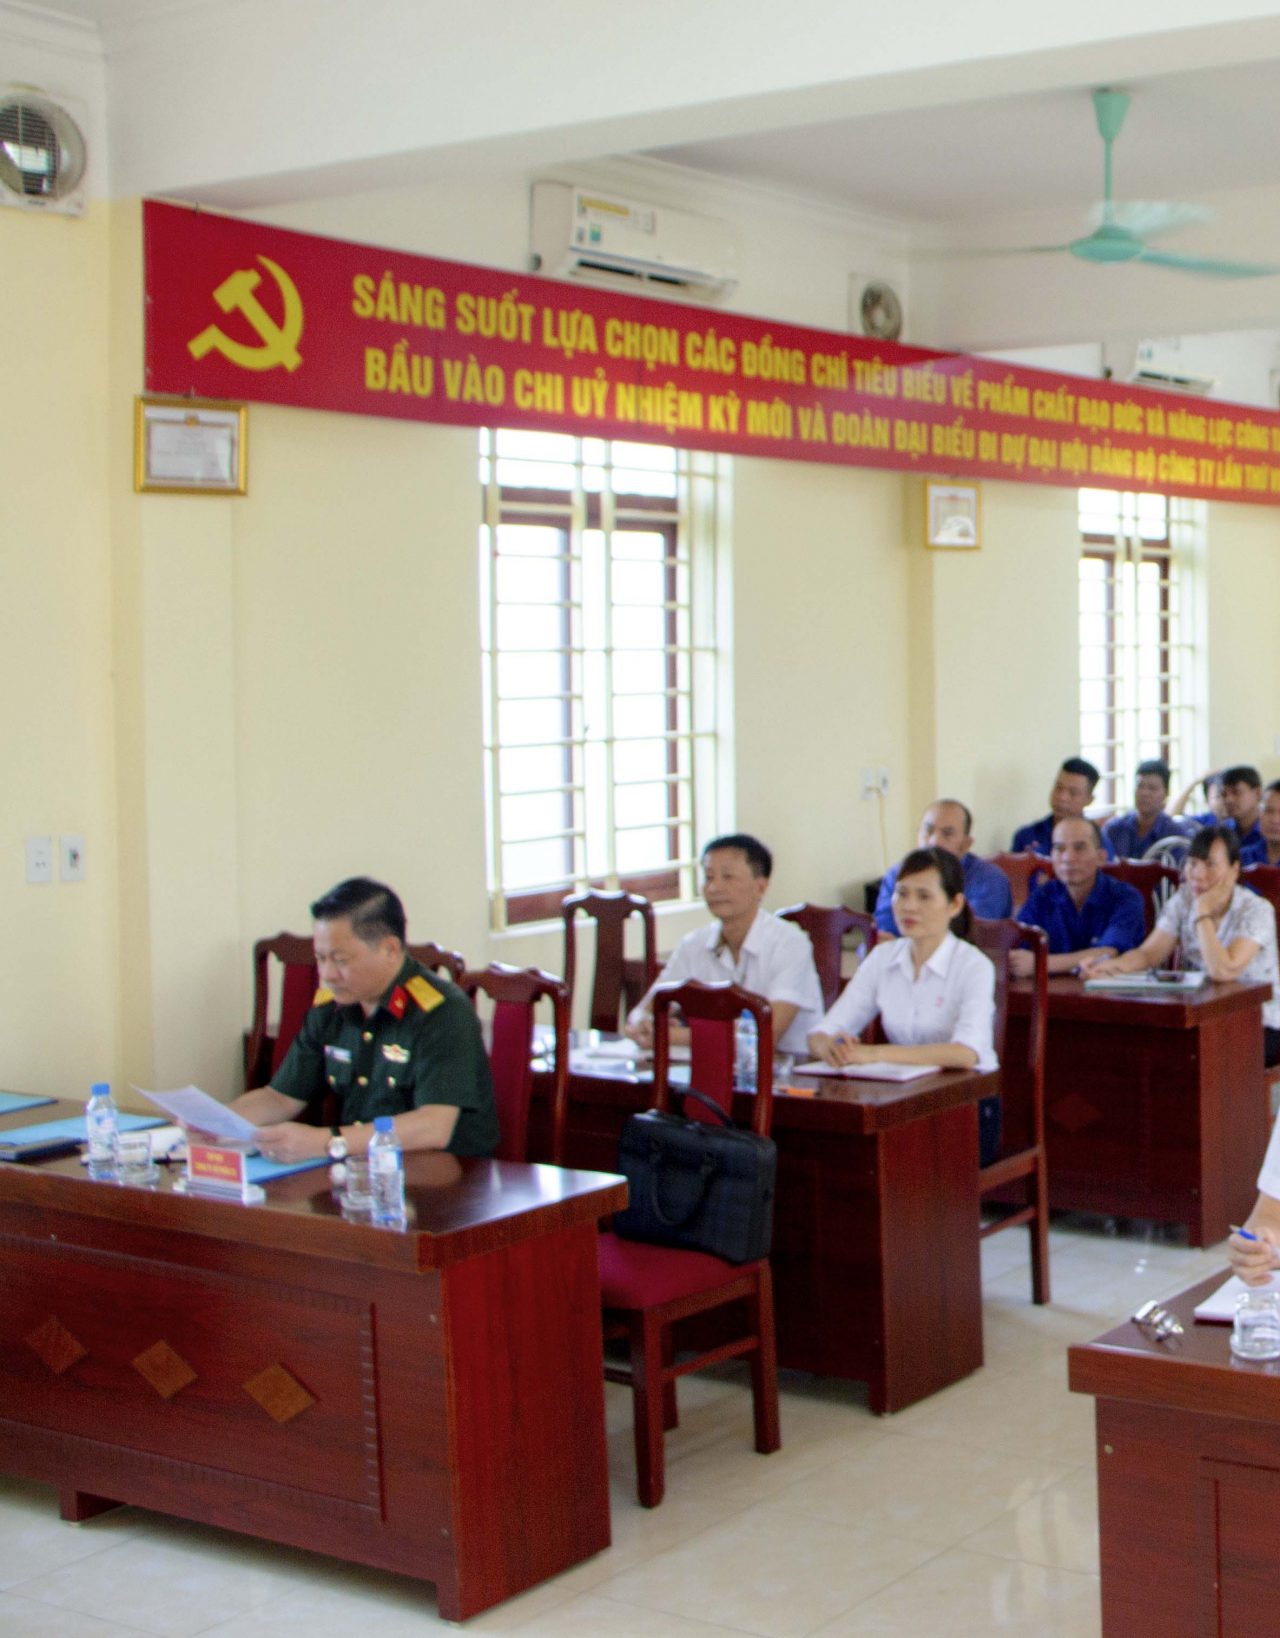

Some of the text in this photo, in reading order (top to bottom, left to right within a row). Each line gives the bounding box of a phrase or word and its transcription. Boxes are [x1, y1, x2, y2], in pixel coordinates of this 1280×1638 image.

[353, 271, 445, 328] SÁNG
[457, 289, 535, 342] SUỐT
[543, 309, 597, 357] LỰA
[605, 319, 679, 369] CHỌN
[686, 328, 736, 373] CÁC
[742, 334, 805, 383] ĐỒNG
[812, 352, 848, 389] CHÍ
[853, 356, 897, 395] TIÊU
[902, 360, 946, 404] BIỂU
[951, 369, 974, 409] VỀ
[978, 374, 1029, 415] PHẨM
[1033, 384, 1075, 421] CHẤT
[365, 339, 433, 396] BẦU
[443, 354, 505, 405] VÀO
[514, 369, 565, 412] CHI
[572, 367, 608, 418] UỶ
[615, 382, 703, 433] NHIỆM
[709, 390, 741, 431] KỲ
[746, 397, 792, 438] MỚI
[798, 402, 827, 442] VÀ
[832, 408, 889, 447] ĐOÀN
[895, 419, 928, 459] ĐẠI
[933, 416, 975, 458] BIỂU
